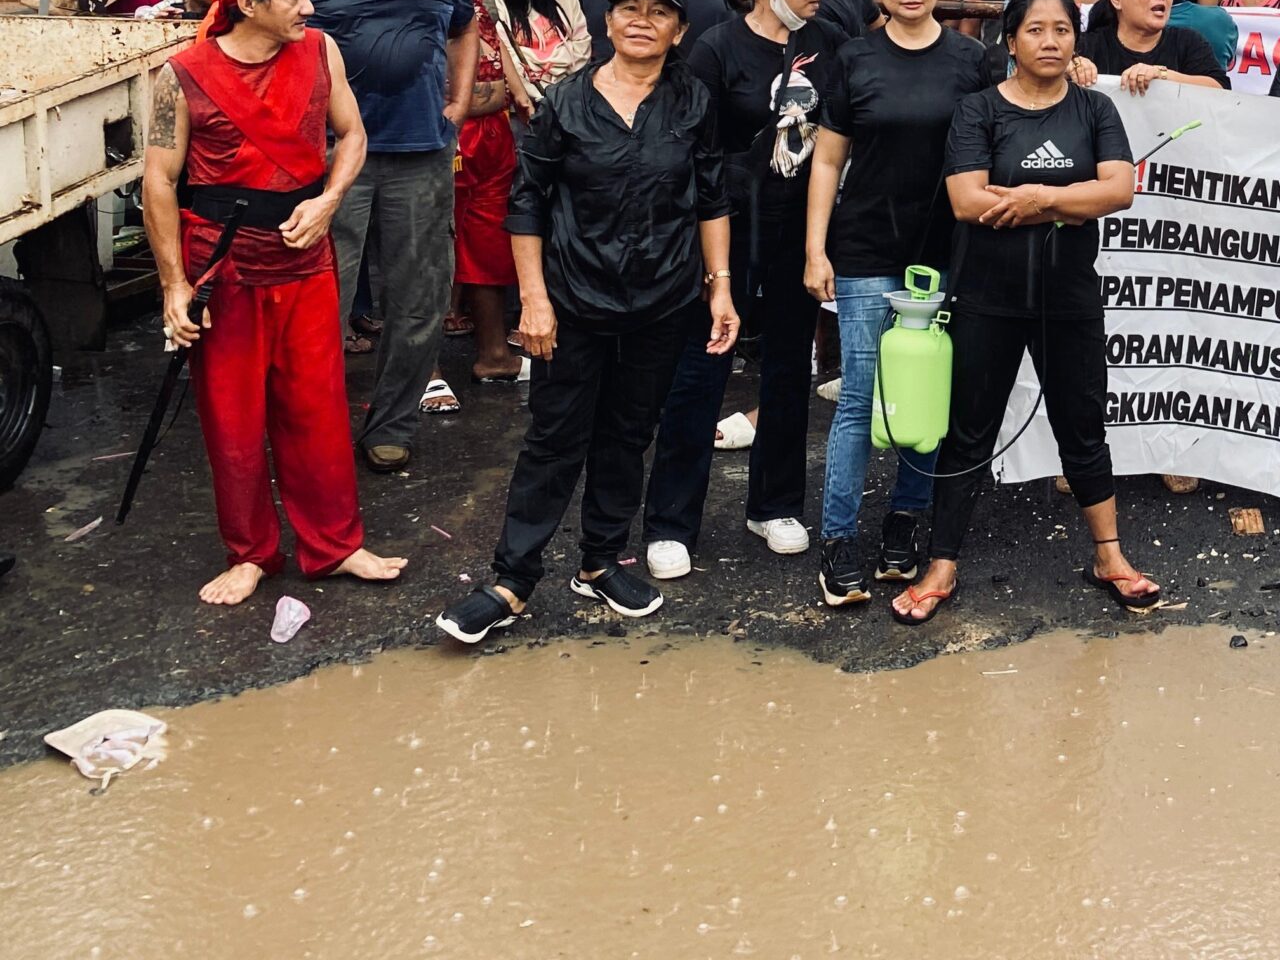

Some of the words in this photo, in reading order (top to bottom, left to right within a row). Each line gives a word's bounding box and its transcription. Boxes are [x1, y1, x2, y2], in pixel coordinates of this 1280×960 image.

[1021, 157, 1074, 168] adidas
[1100, 276, 1153, 307] PAT
[1105, 334, 1184, 364] ORAN
[1104, 391, 1232, 427] GKUNGAN
